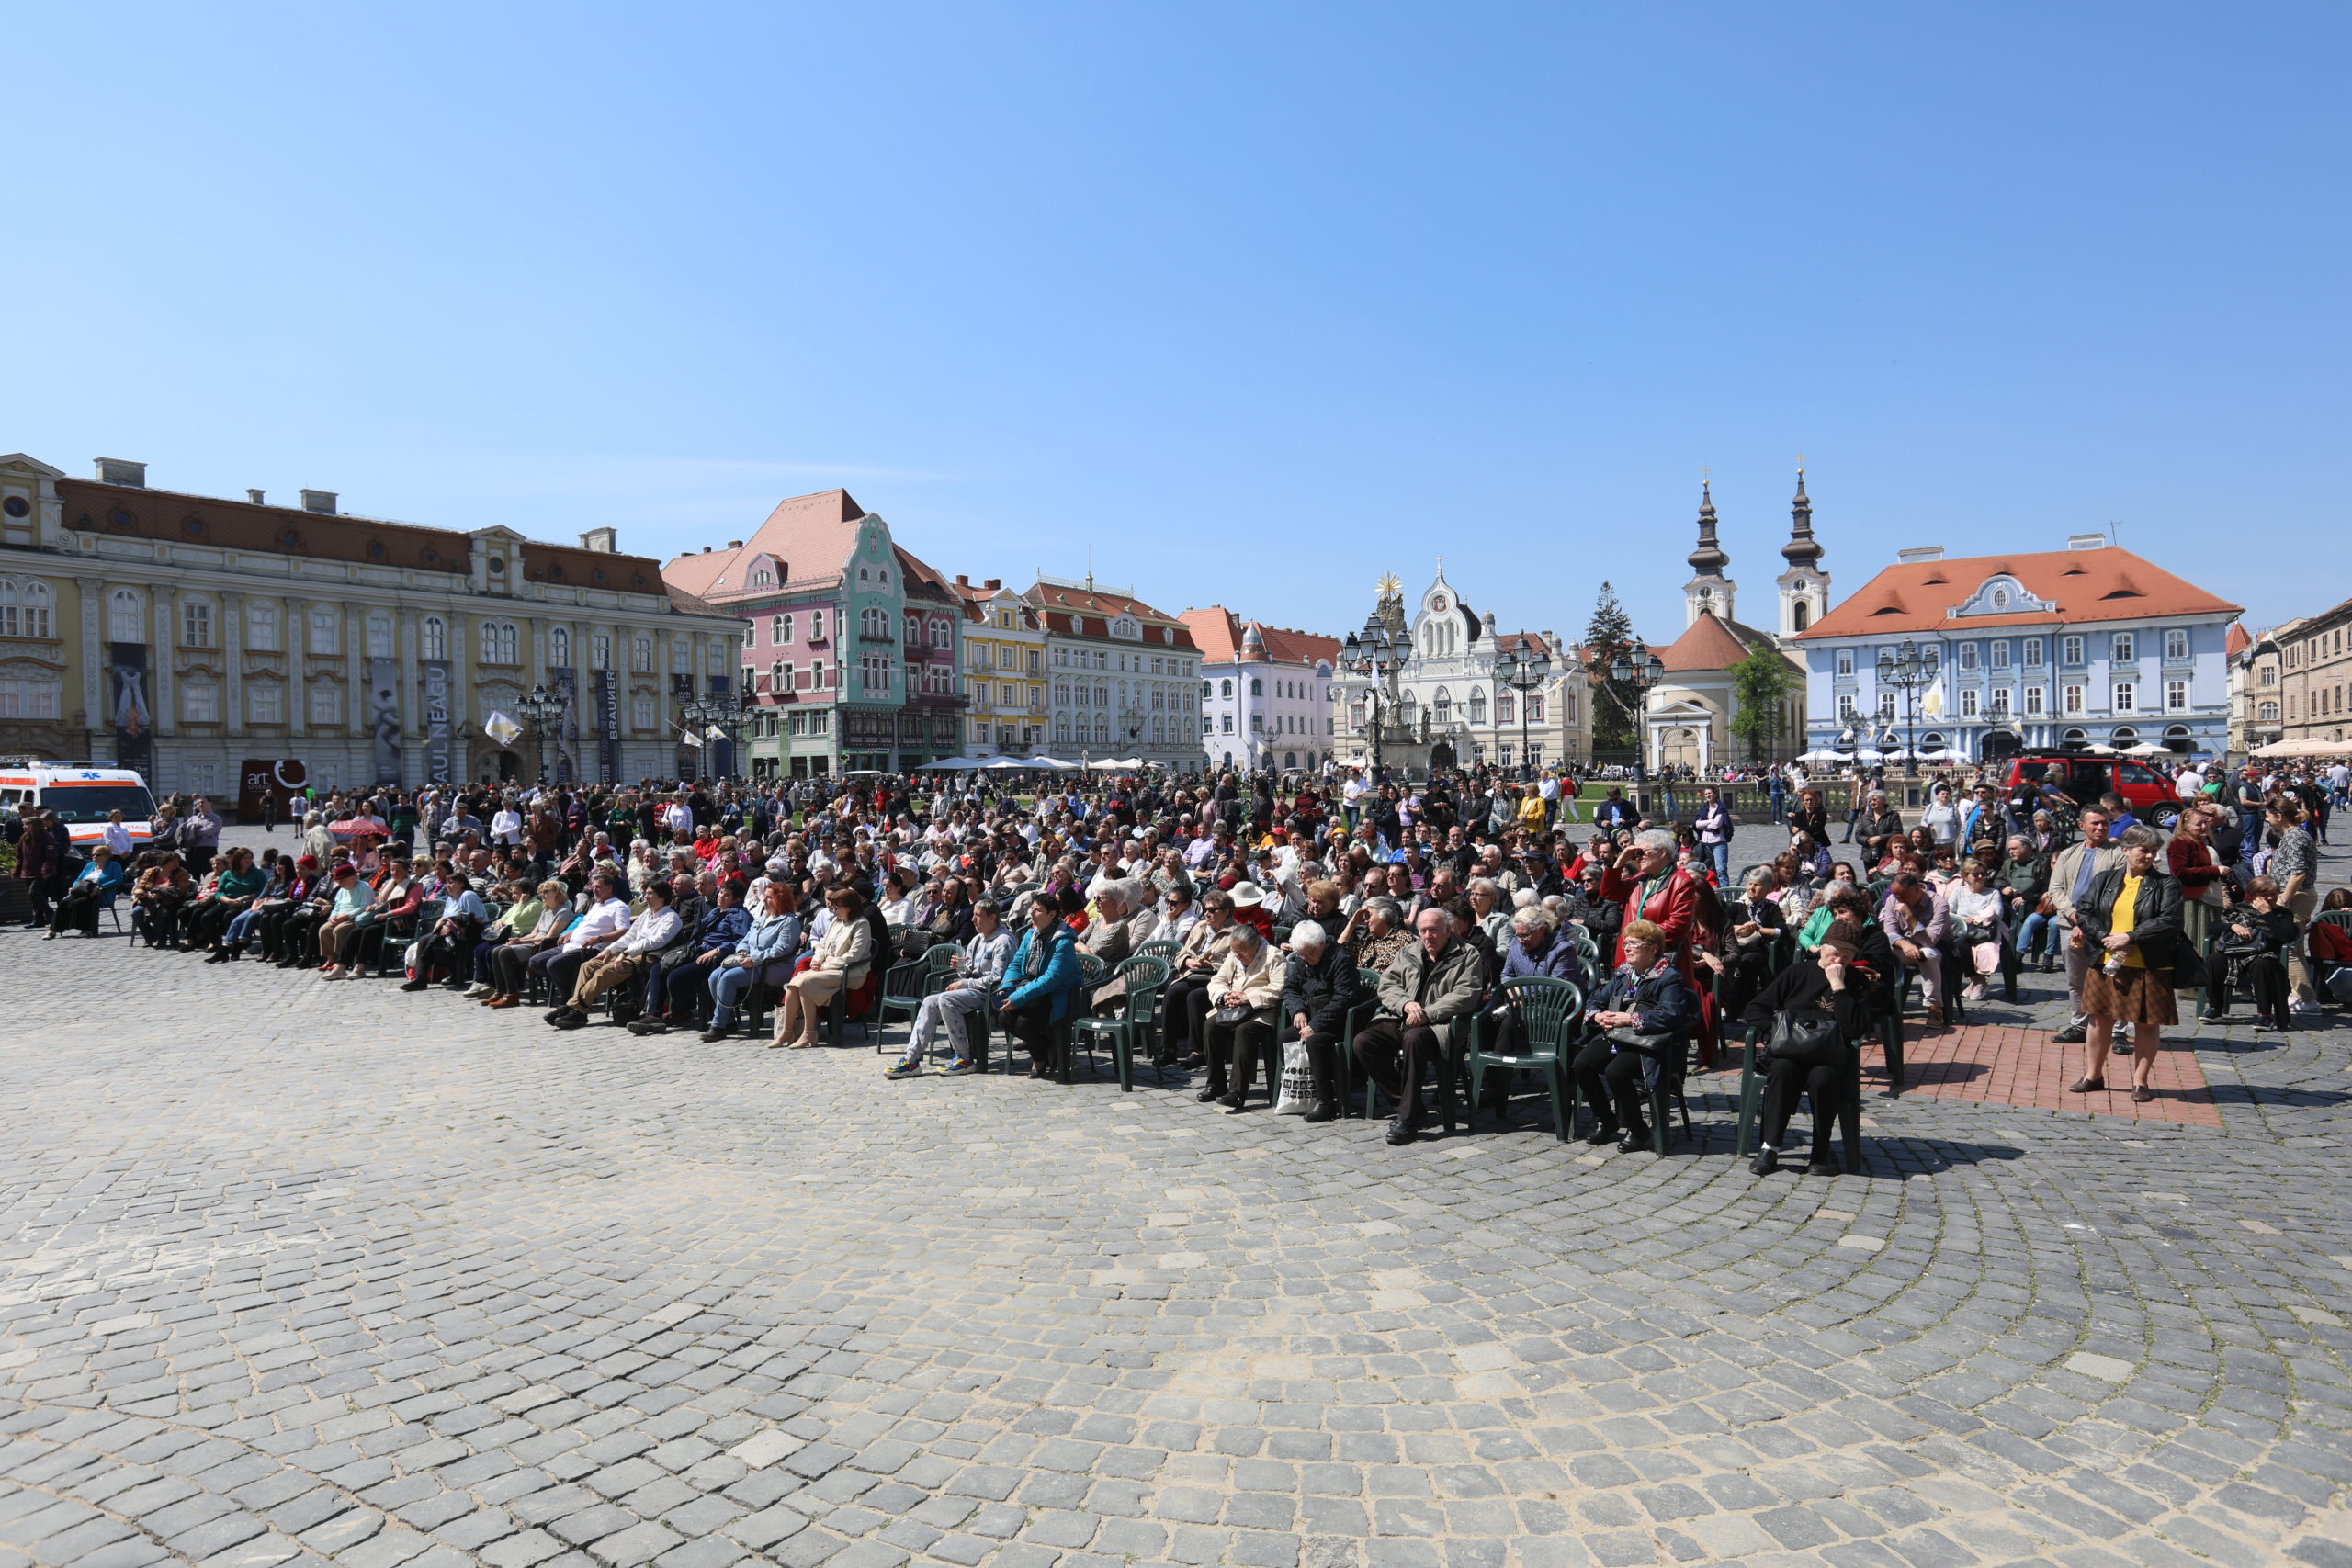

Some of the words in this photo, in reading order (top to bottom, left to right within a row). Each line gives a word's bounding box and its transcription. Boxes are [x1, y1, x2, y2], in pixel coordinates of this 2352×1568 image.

[430, 667, 447, 738] NEAGU
[248, 772, 269, 785] art
[433, 742, 448, 787] AUL
